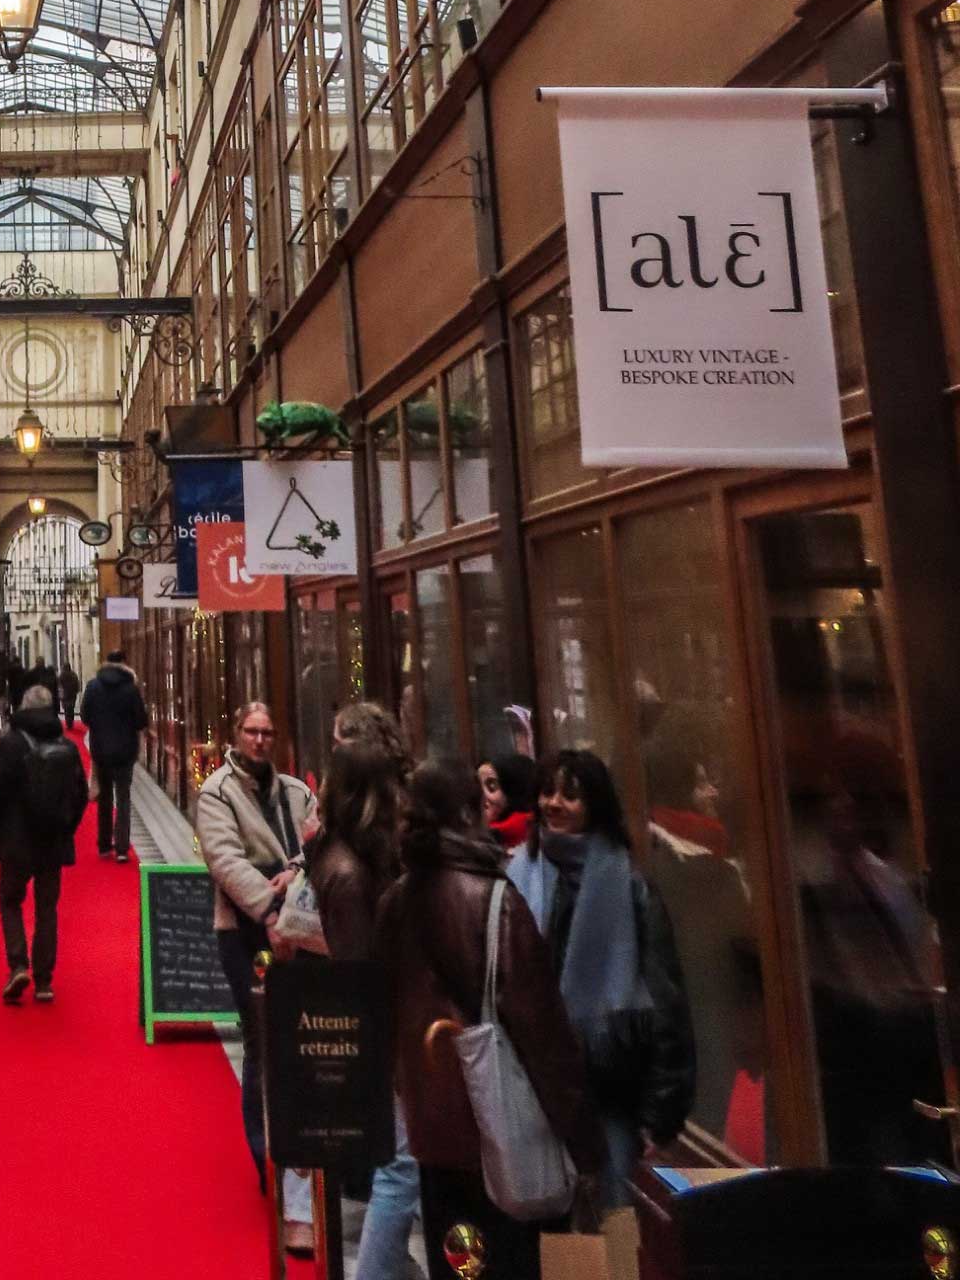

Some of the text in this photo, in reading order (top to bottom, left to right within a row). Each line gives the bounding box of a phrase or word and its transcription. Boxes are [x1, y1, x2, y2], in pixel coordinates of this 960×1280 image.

[623, 348, 694, 364] LUXURY
[698, 348, 780, 364] VINTAGE
[621, 370, 795, 385] BESPOKE CREATION
[298, 1010, 360, 1030] Attente
[300, 1039, 359, 1056] retraits
